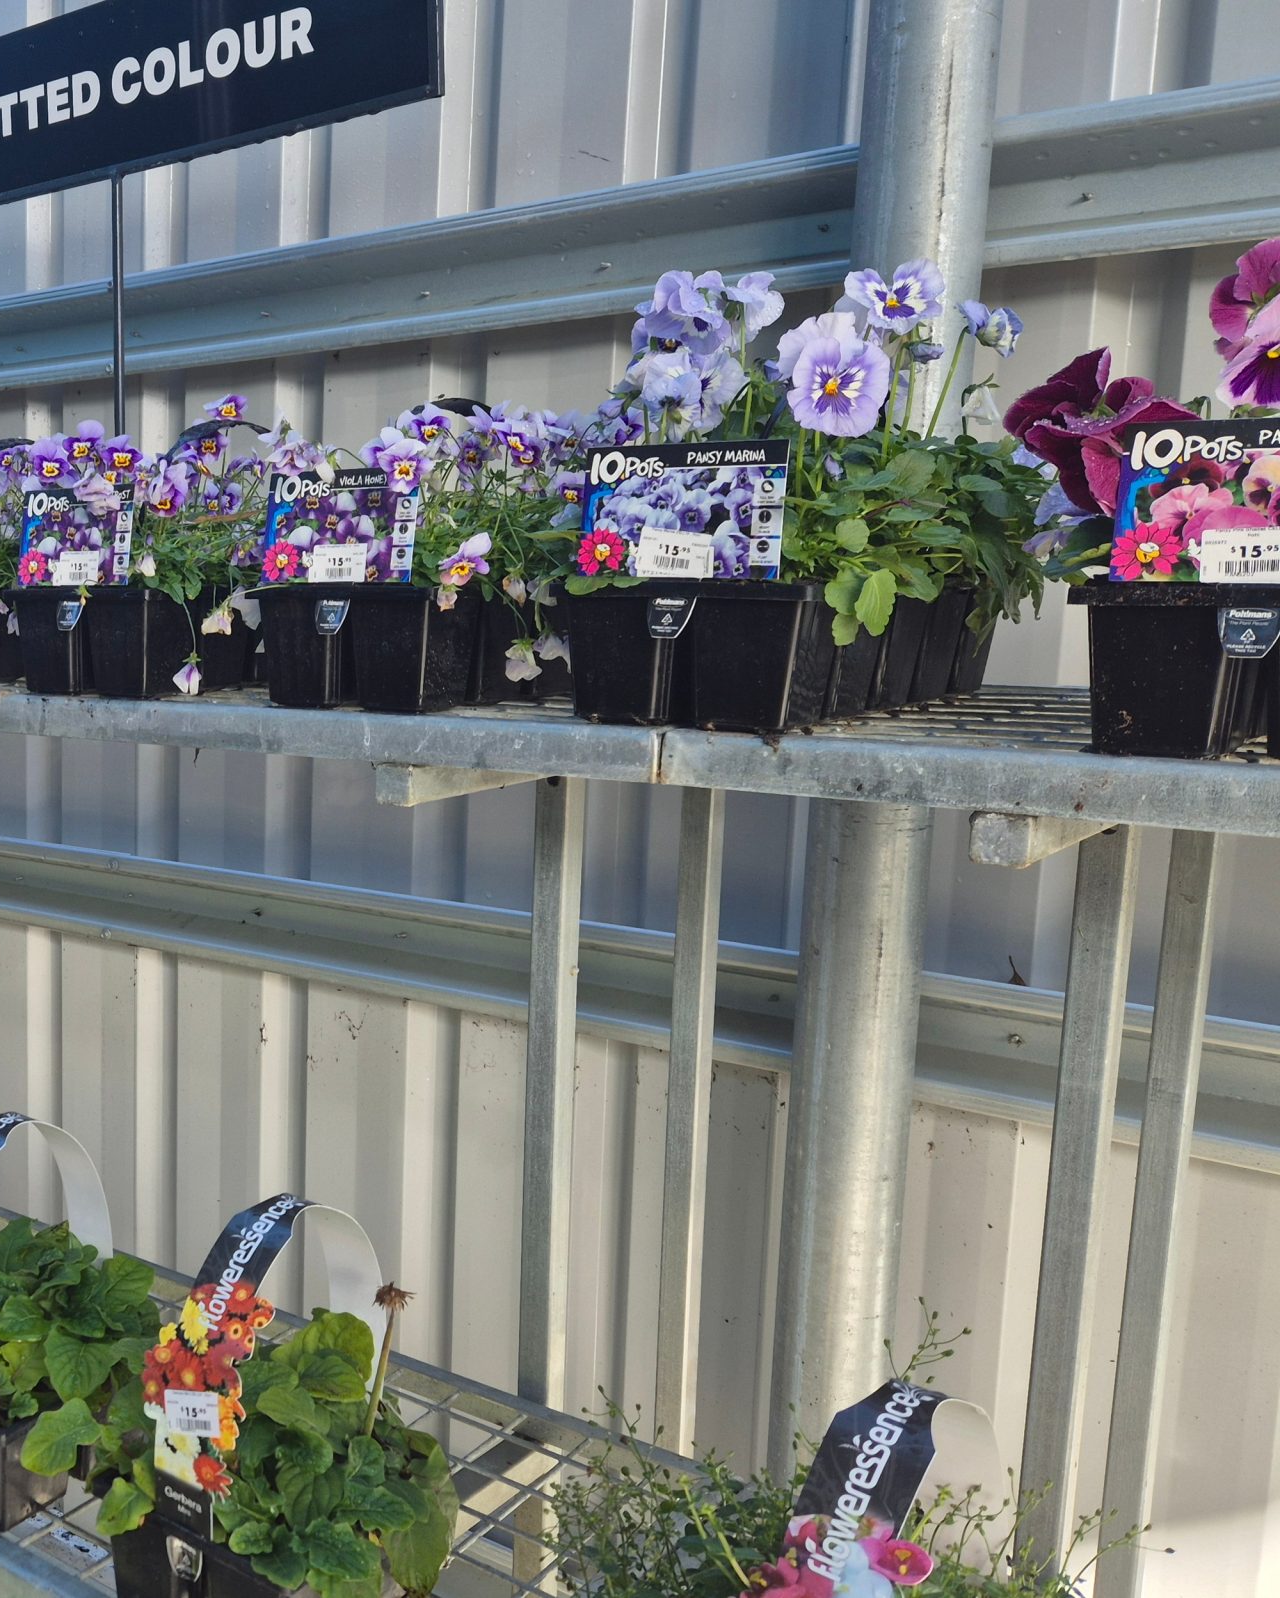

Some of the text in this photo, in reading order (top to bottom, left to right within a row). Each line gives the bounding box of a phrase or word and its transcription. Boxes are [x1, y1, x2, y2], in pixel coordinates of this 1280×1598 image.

[111, 6, 315, 105] COLOUR
[687, 449, 766, 464] PANSY MARINA
[339, 475, 363, 487] VIOLA
[659, 543, 690, 556] $15.95
[1230, 545, 1279, 558] $15.95
[198, 1198, 295, 1331] floweressence
[806, 1391, 921, 1583] floweressence
